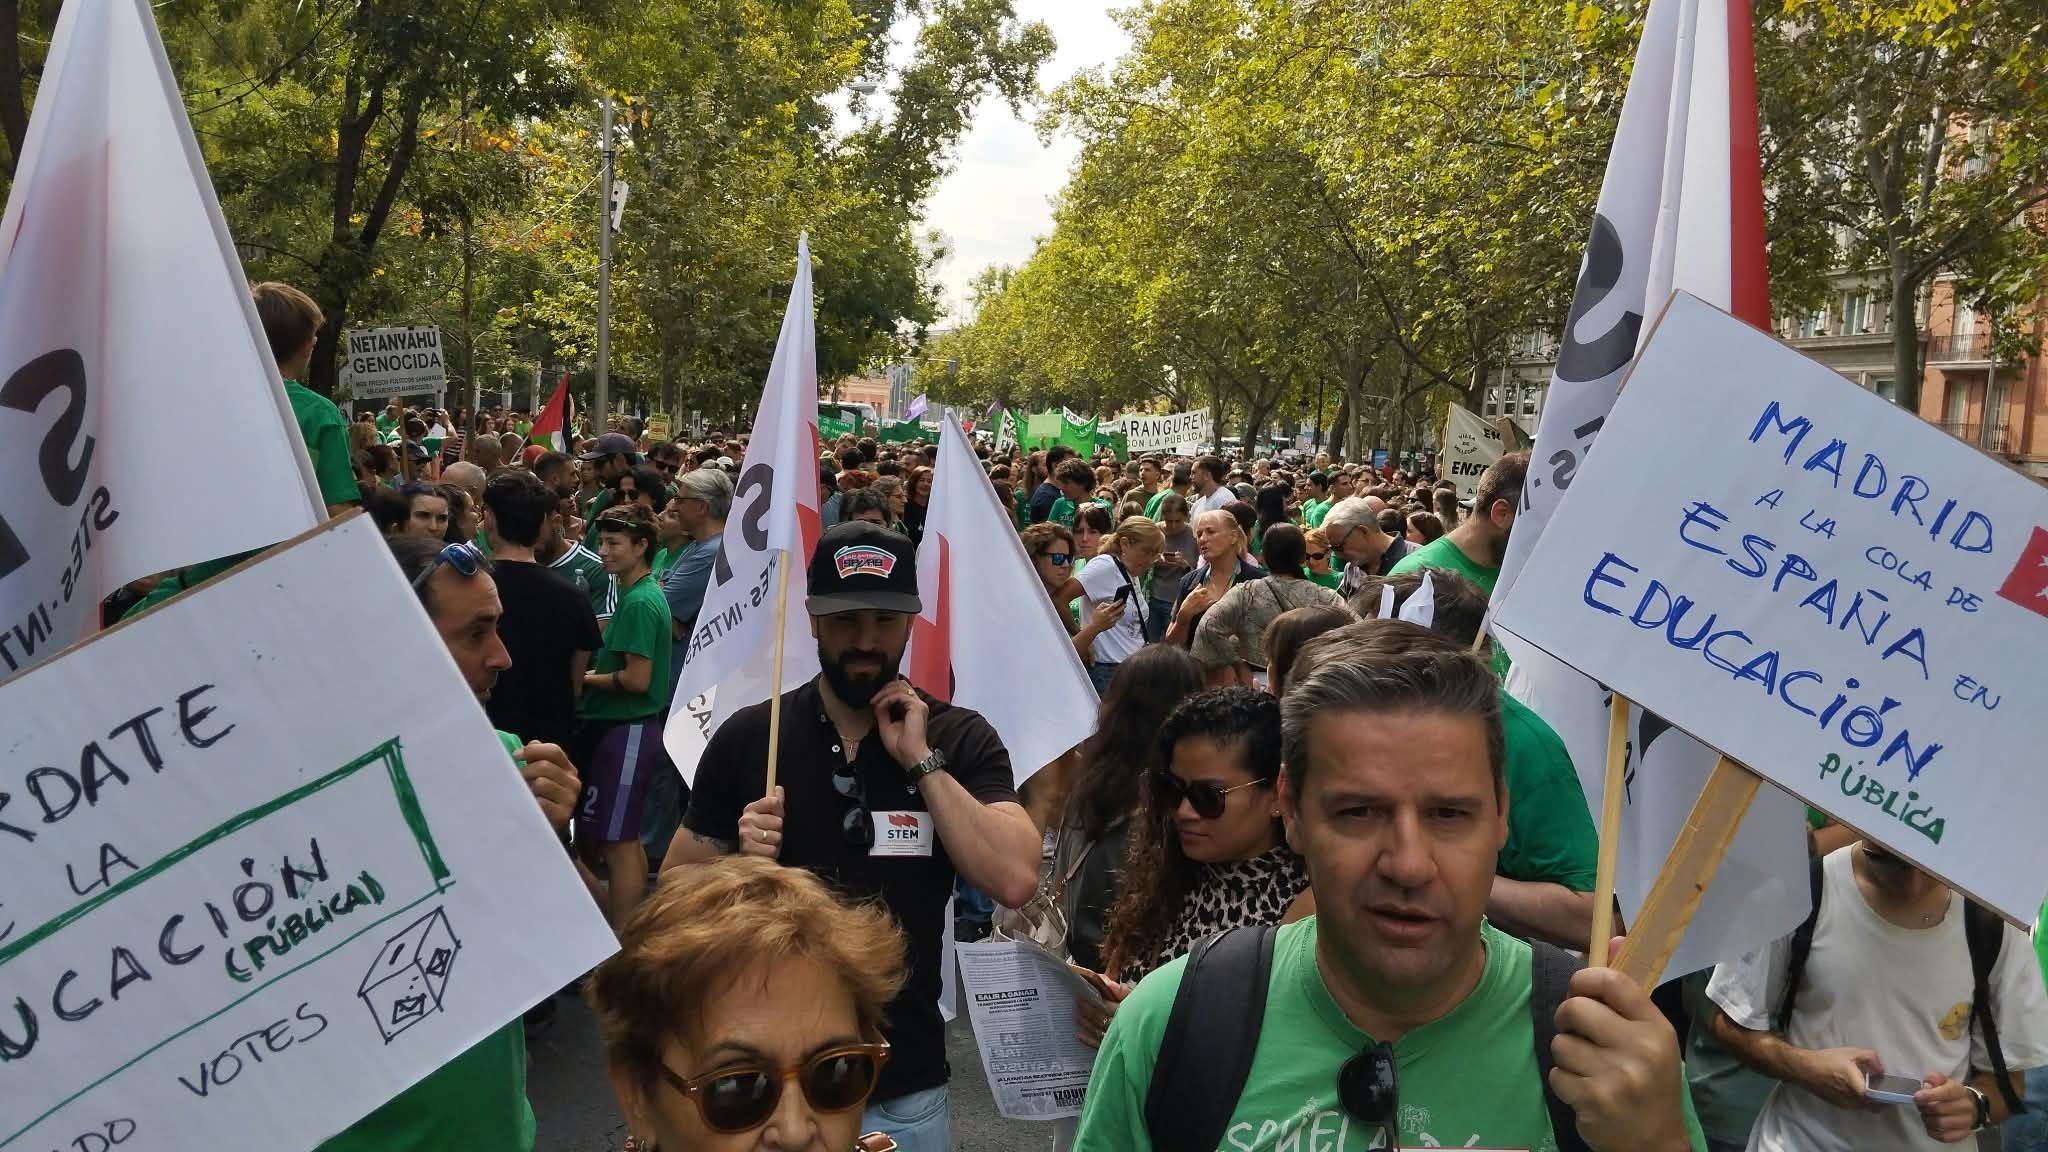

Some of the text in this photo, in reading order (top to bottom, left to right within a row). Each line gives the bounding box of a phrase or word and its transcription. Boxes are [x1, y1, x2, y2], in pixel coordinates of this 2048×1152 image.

[350, 331, 437, 354] NETANYAHU
[353, 351, 442, 374] GENOCIDA
[1120, 411, 1208, 437] ARANGUREN
[1149, 438, 1161, 447] LA
[1749, 401, 1992, 553] MADRID
[1755, 489, 1983, 612] A LA COLA DE
[1679, 502, 1929, 680] ESPAÑA
[1584, 552, 1943, 783] EDUCACIÓN
[1954, 674, 2001, 710] EN
[583, 785, 599, 815] 2
[1819, 753, 1945, 844] PÚBLICA
[888, 829, 919, 840] STEM
[66, 843, 140, 896] LA
[977, 992, 1001, 1001] SALIR
[1008, 989, 1037, 998] GANAR
[178, 1003, 328, 1096] VOTES
